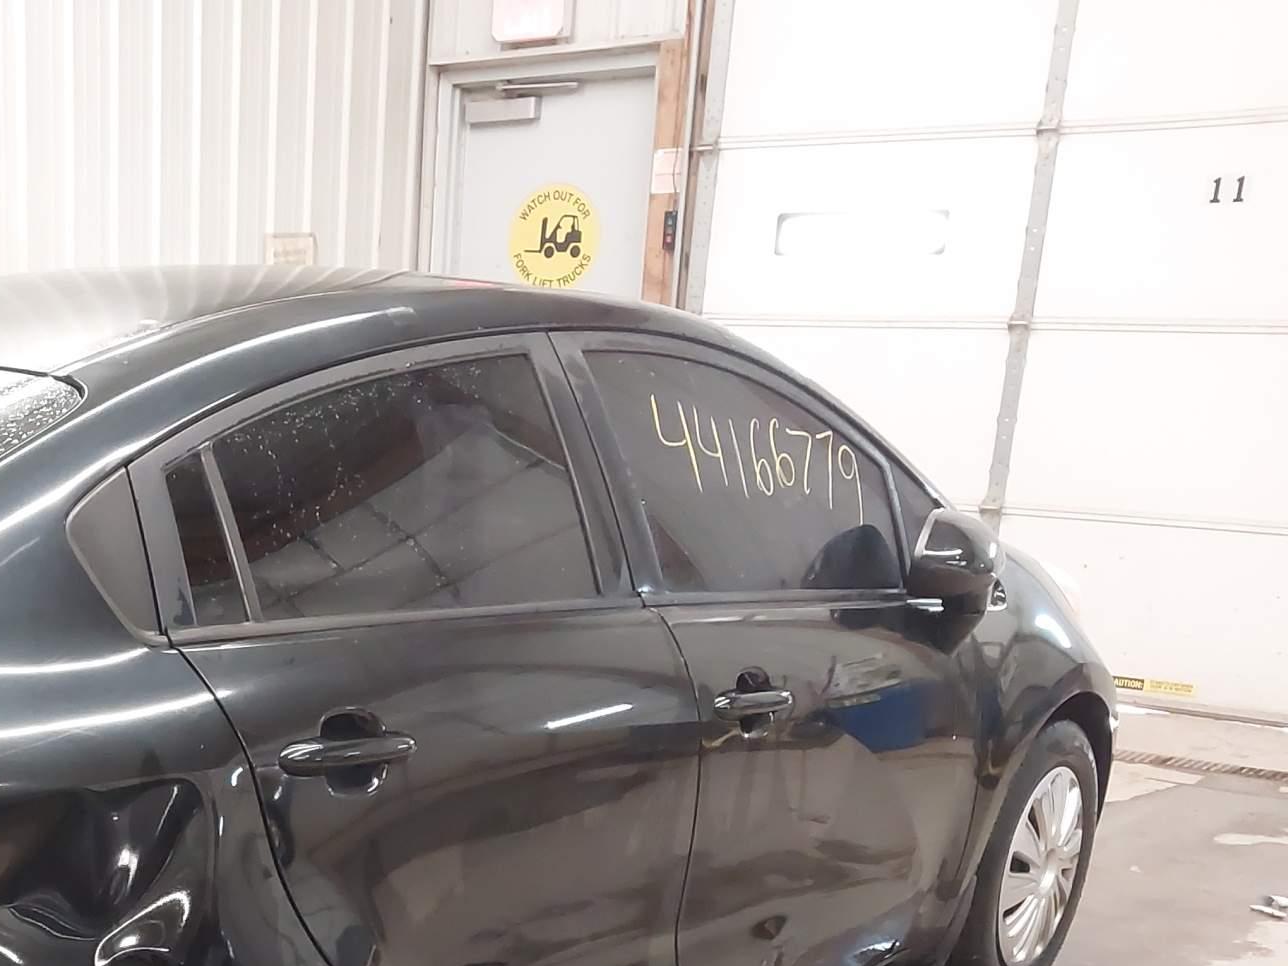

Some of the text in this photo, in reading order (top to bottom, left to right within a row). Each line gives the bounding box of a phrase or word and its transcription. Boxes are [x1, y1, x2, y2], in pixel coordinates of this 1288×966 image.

[519, 189, 591, 221] WATCH OUT FOR
[1209, 175, 1246, 204] 11
[513, 253, 592, 288] FORK LIFT TRUCKS
[649, 393, 864, 526] 44166779
[1113, 677, 1143, 690] AUTION:
